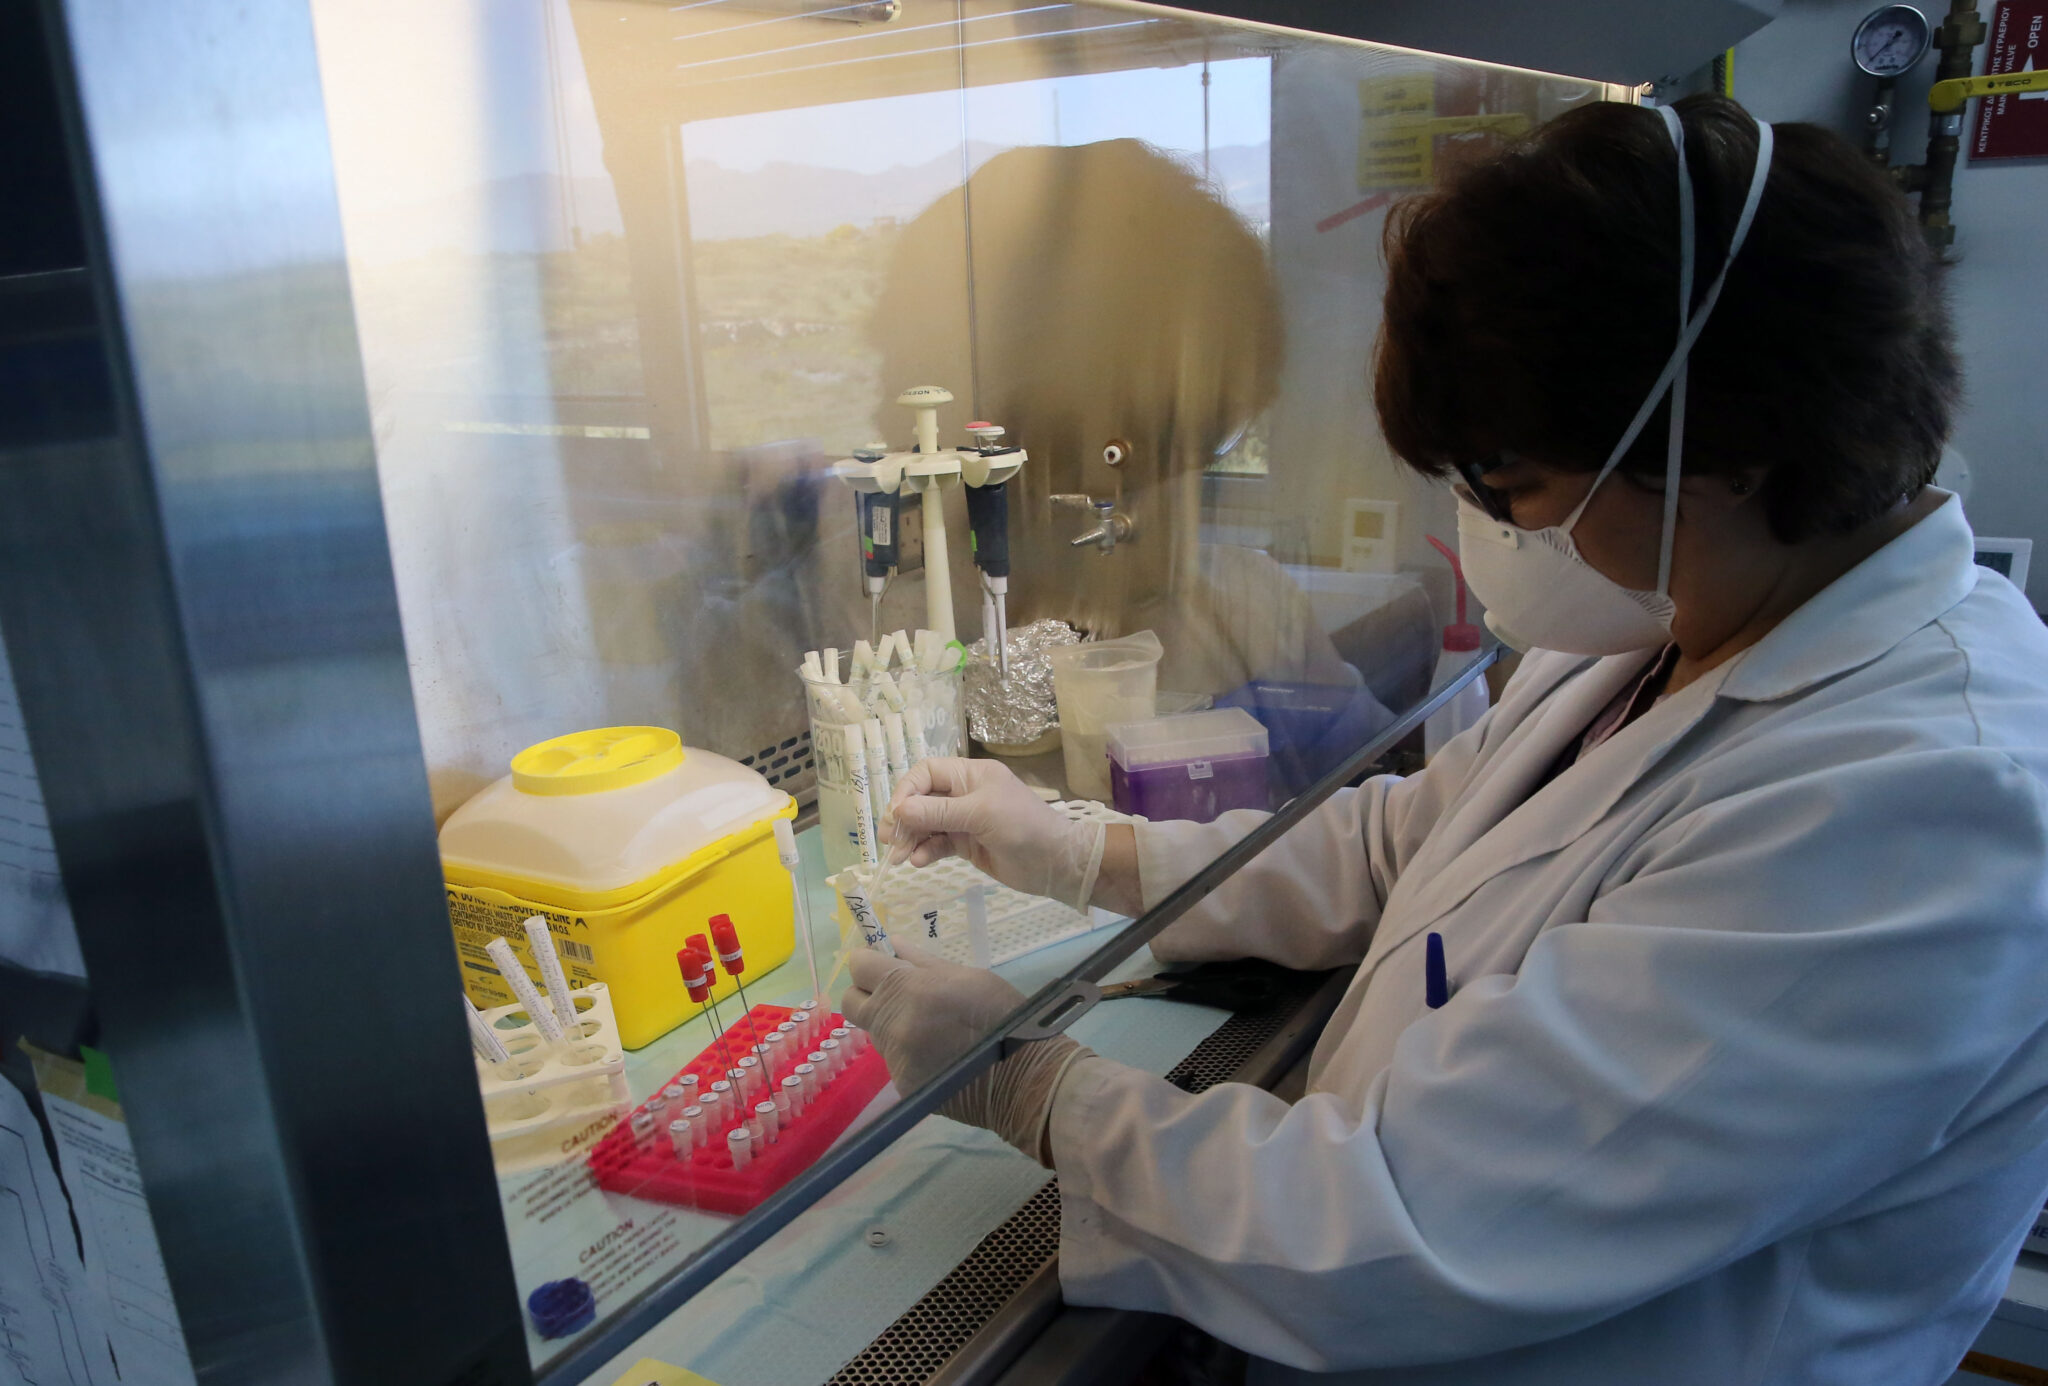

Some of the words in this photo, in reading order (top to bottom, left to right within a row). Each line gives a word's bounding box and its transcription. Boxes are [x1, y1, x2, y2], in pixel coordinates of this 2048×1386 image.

[2027, 15, 2043, 48] OPEN
[561, 1111, 618, 1153] CAUTION
[578, 1218, 633, 1264] CAUTION
